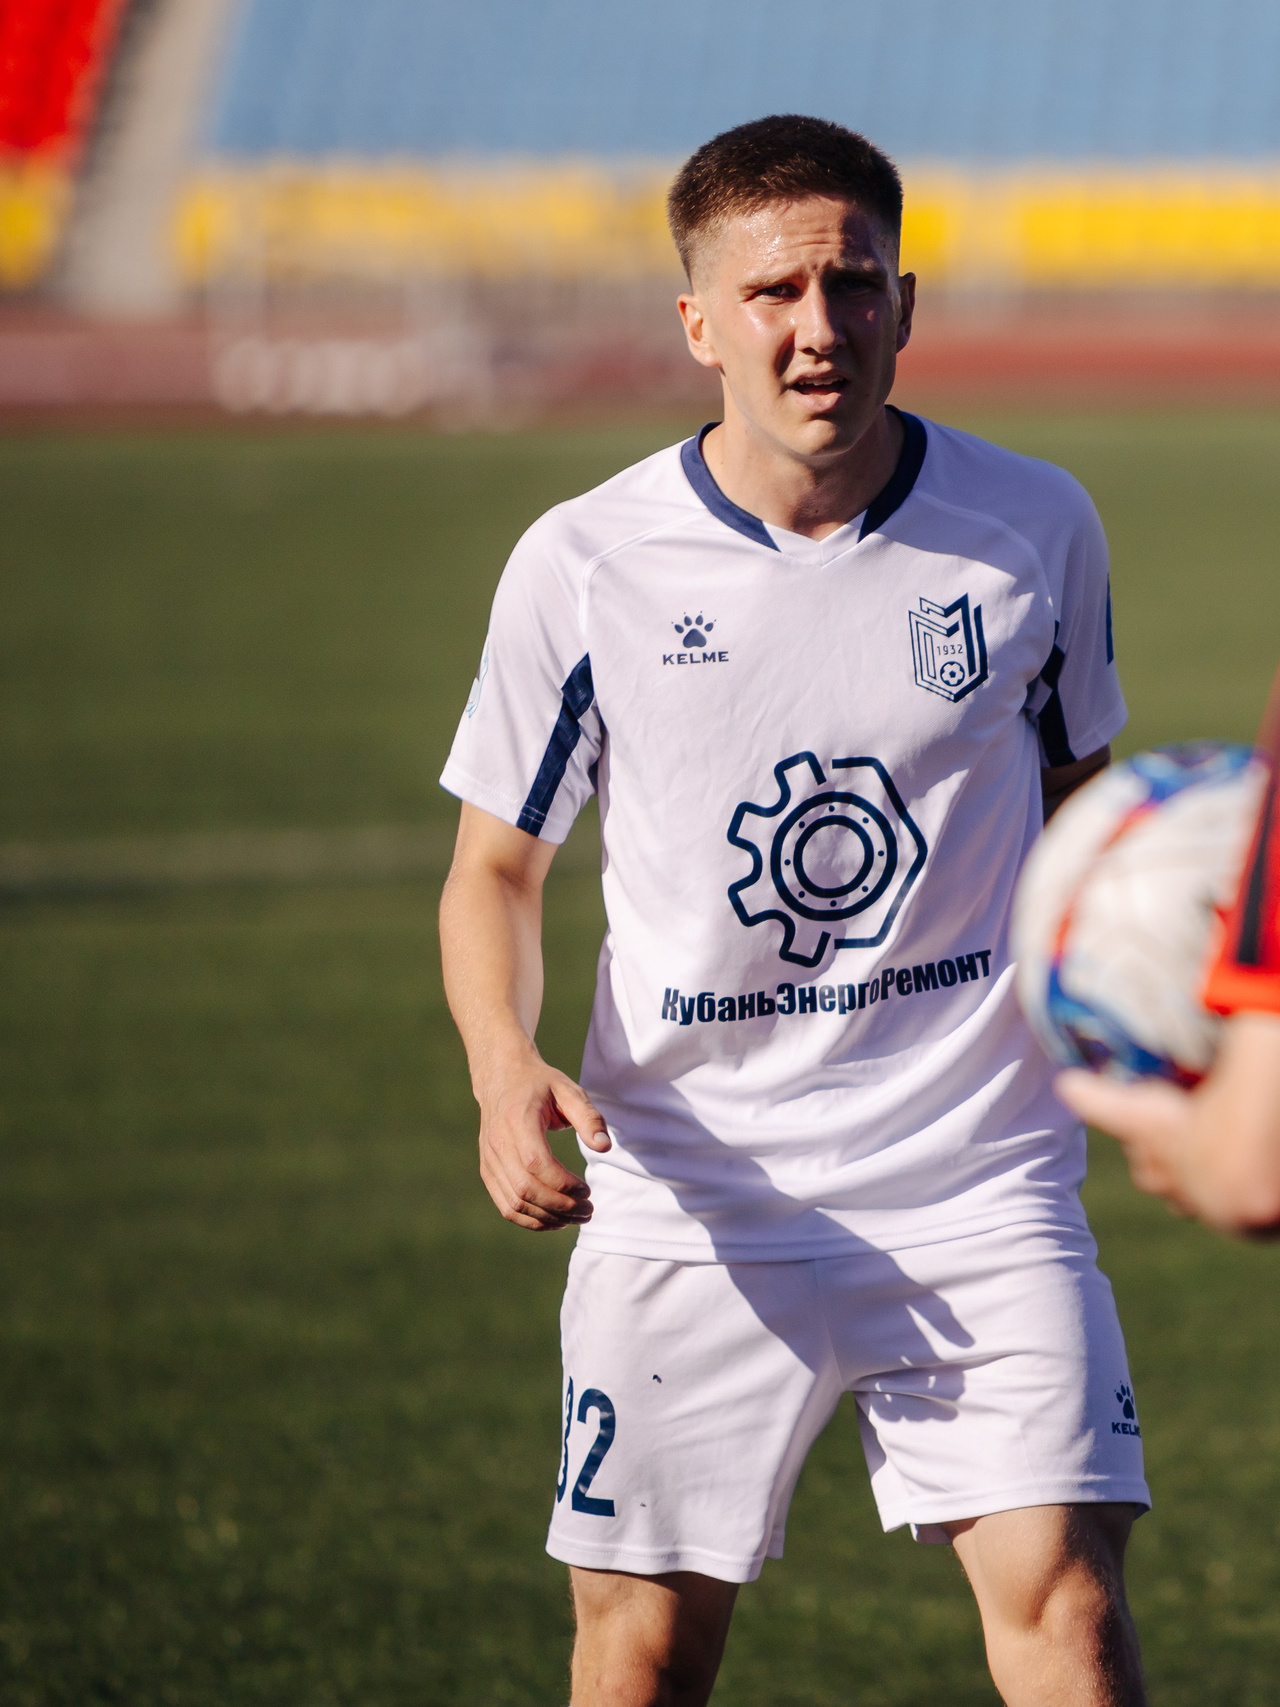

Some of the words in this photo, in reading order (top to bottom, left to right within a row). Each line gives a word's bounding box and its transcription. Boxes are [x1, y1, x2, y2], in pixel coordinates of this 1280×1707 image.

[936, 643, 964, 656] 1932
[662, 651, 729, 665] KELME
[661, 949, 992, 1026] КубаньЭнергоРемонт
